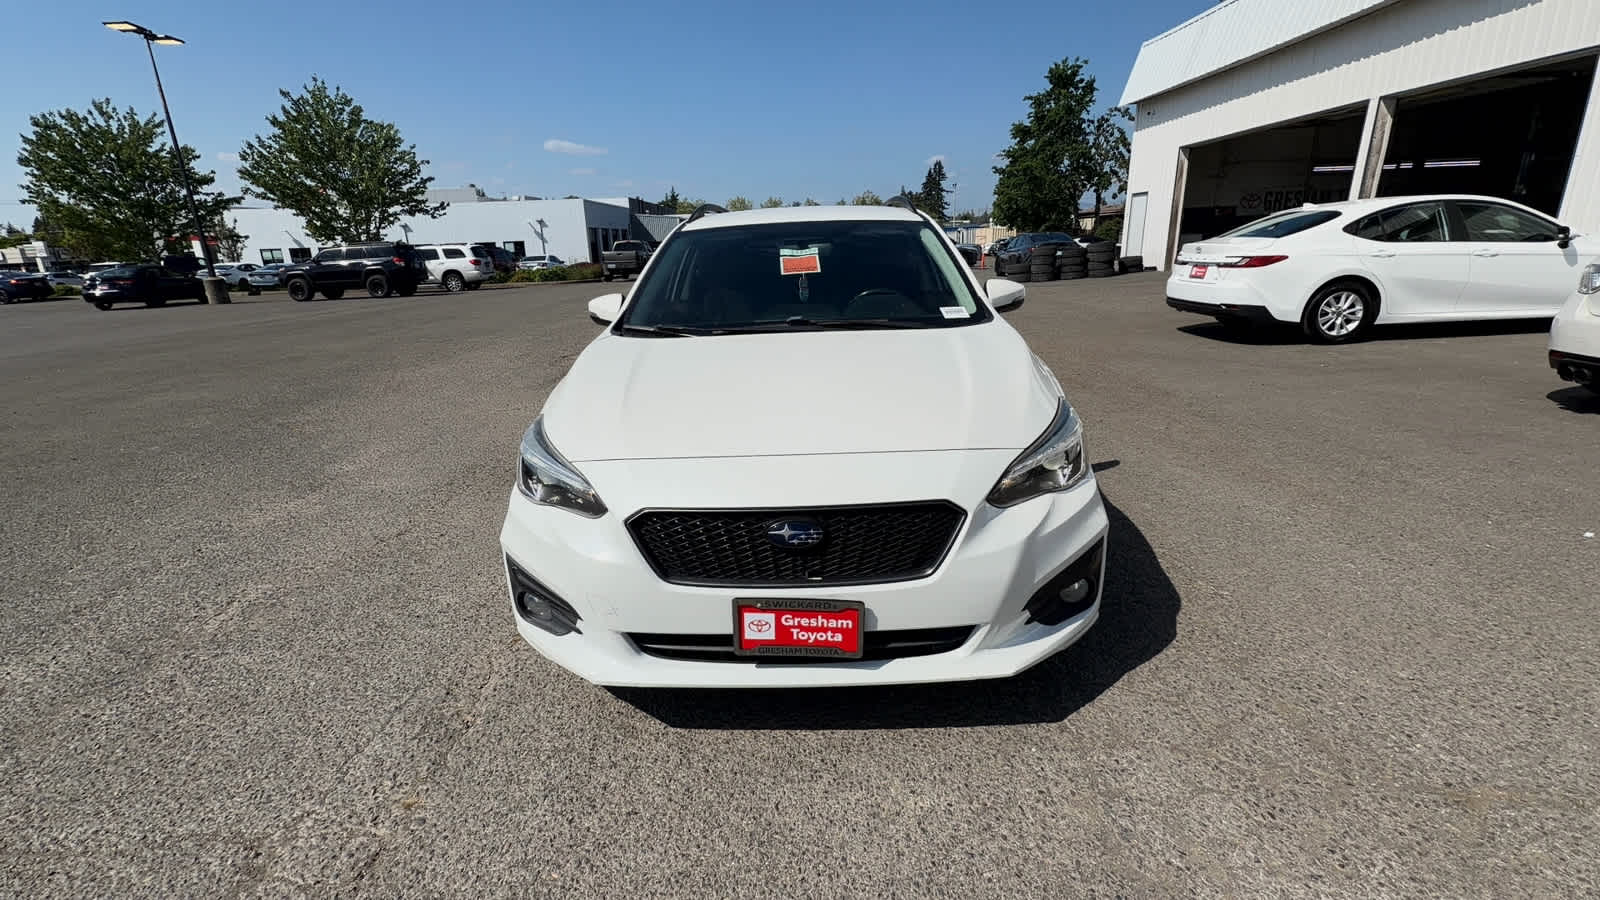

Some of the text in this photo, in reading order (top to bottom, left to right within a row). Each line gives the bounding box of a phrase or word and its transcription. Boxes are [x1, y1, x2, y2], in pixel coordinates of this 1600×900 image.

[763, 601, 831, 609] SWICKARD
[781, 614, 852, 628] Gresham
[790, 629, 842, 642] Toyota
